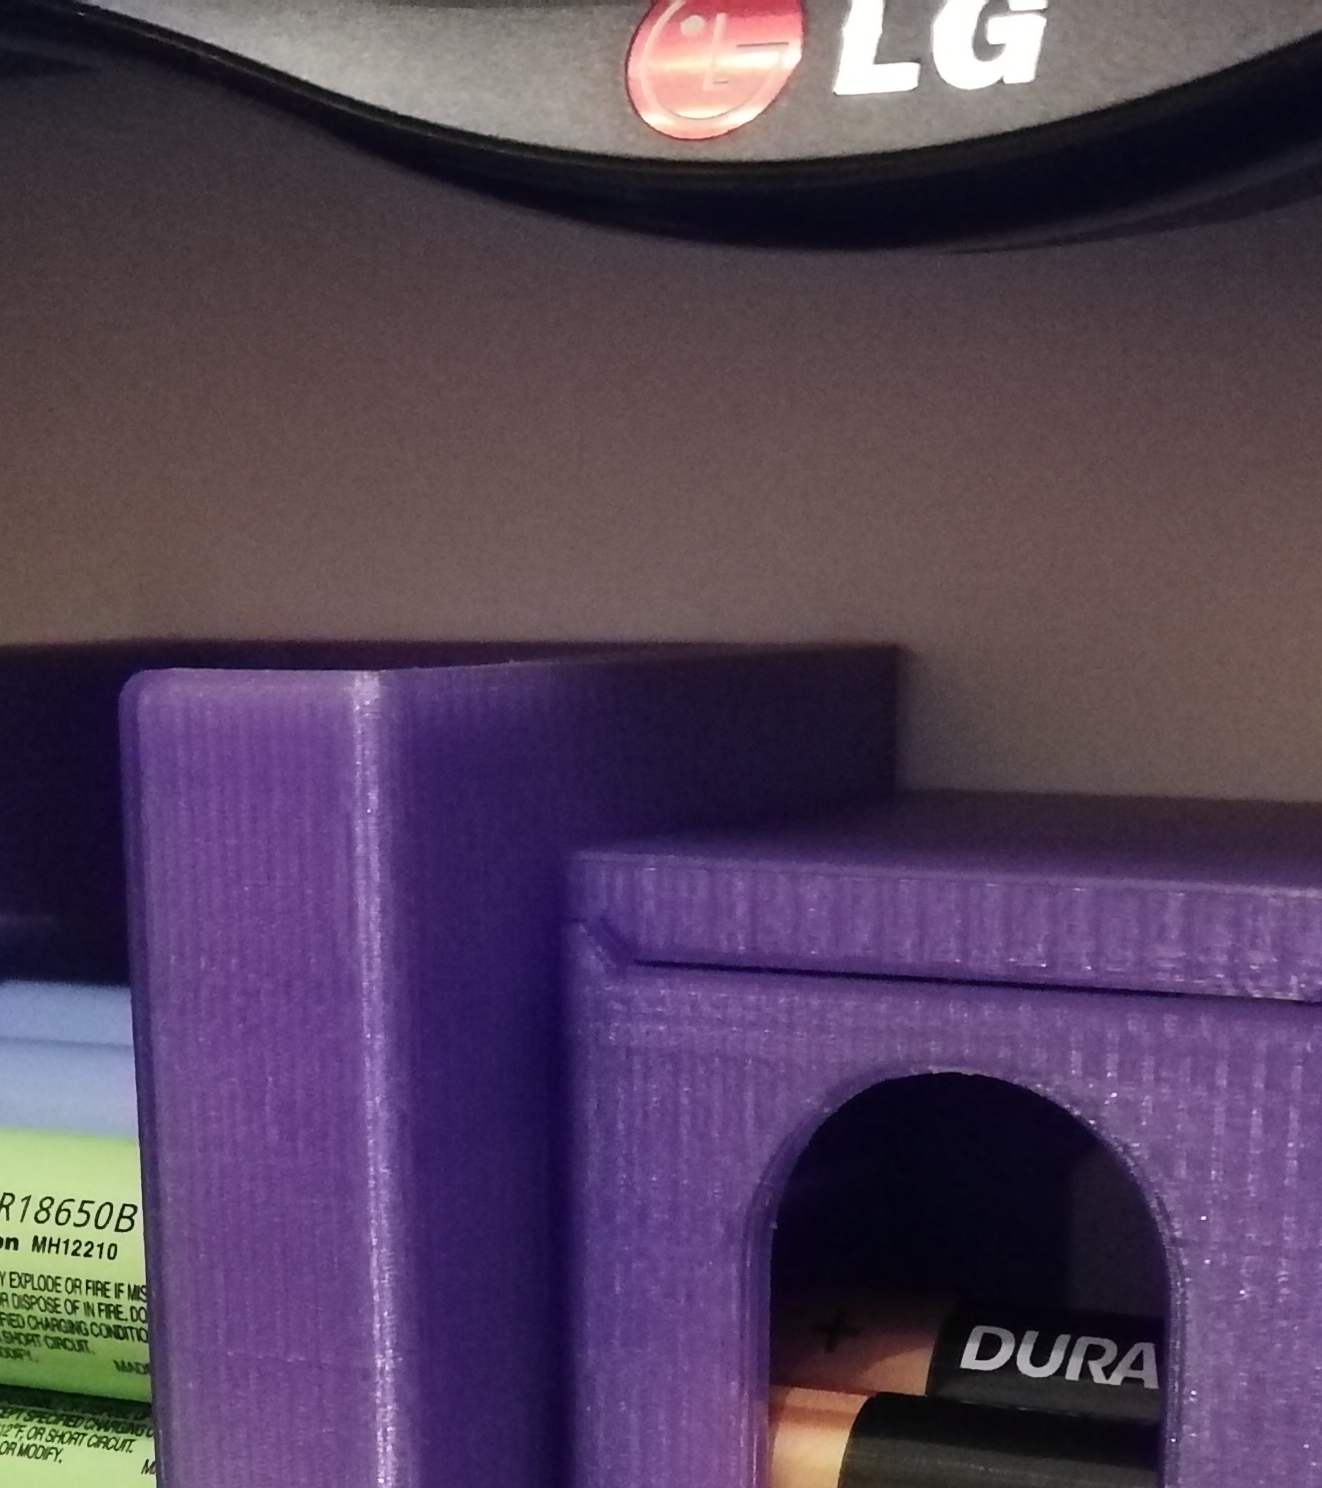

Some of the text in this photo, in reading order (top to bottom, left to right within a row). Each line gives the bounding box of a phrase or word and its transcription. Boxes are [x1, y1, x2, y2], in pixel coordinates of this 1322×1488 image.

[832, 0, 1047, 96] LG
[31, 1235, 118, 1260] MH12210
[9, 1271, 62, 1293] EXPLODE
[65, 1277, 82, 1296] OR
[85, 1279, 111, 1299] FIRE
[114, 1282, 125, 1300] IF
[12, 1293, 62, 1314] DISPOSE
[64, 1298, 80, 1316] OF
[960, 1325, 1159, 1390] DURA
